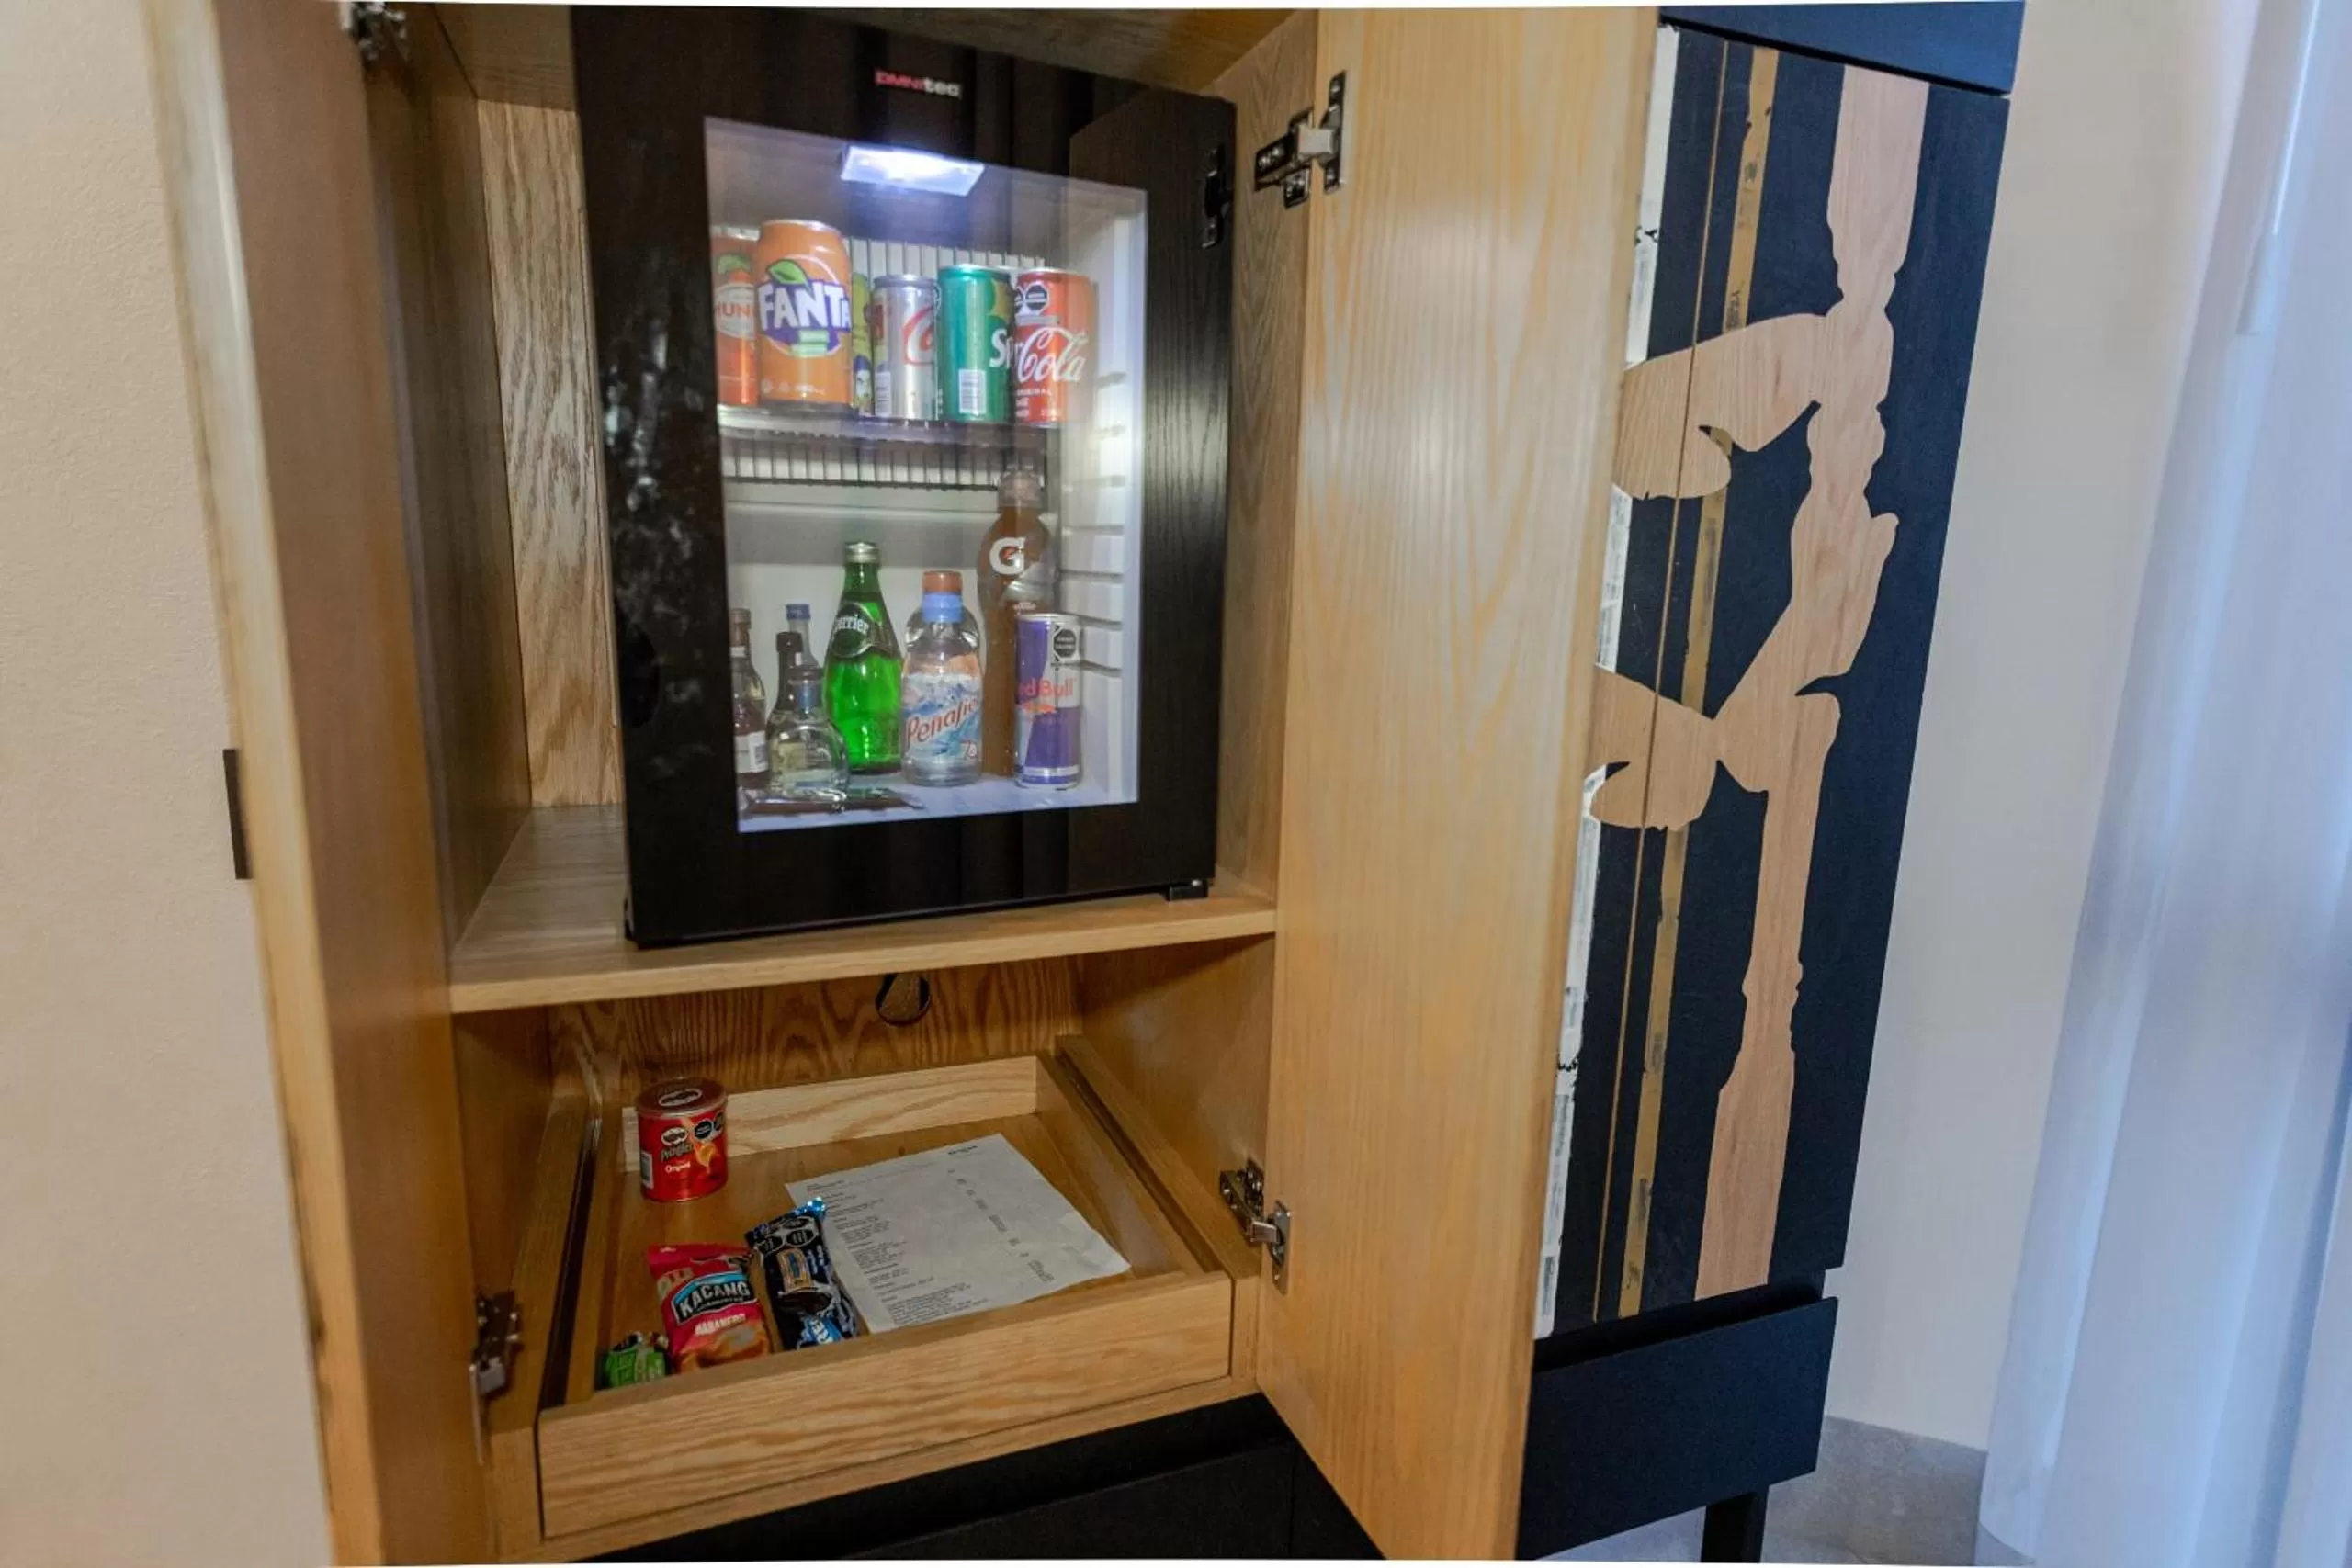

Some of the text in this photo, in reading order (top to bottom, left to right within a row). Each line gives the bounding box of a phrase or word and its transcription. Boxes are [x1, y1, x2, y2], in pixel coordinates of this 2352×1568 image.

[989, 537, 1026, 575] G
[1039, 677, 1074, 698] Bull
[678, 1280, 751, 1319] KACANG
